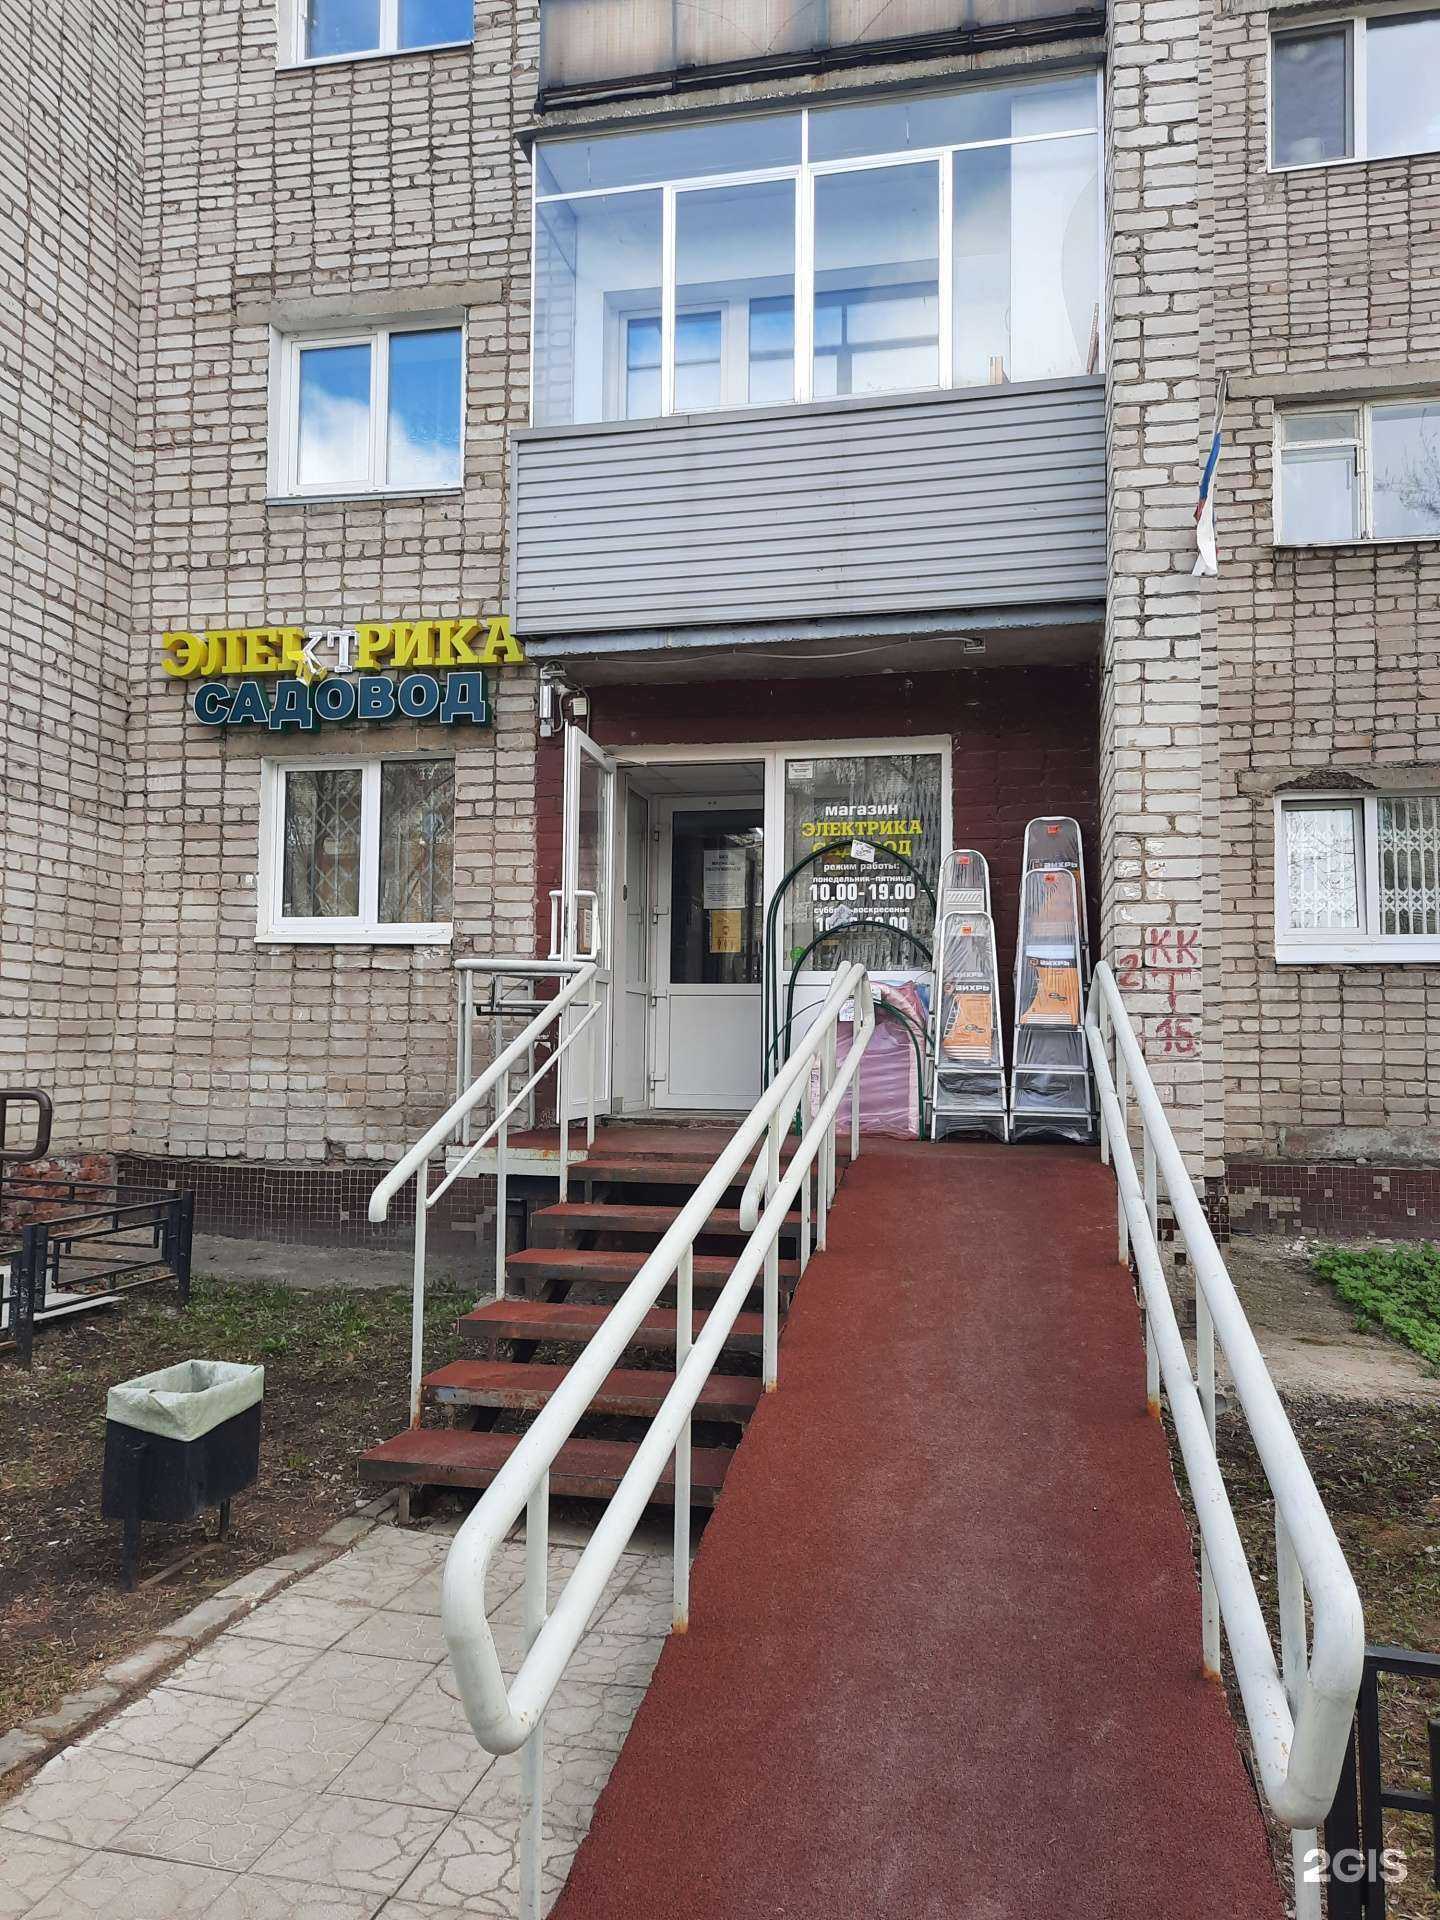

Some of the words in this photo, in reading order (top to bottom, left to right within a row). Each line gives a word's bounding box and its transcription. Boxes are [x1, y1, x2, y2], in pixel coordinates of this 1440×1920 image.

[193, 671, 488, 731] САДОВОД
[825, 804, 899, 816] магазин
[802, 819, 923, 837] ЭЛЕКТРИКА
[823, 863, 857, 872] режим
[955, 983, 990, 992] ВИХРЬ
